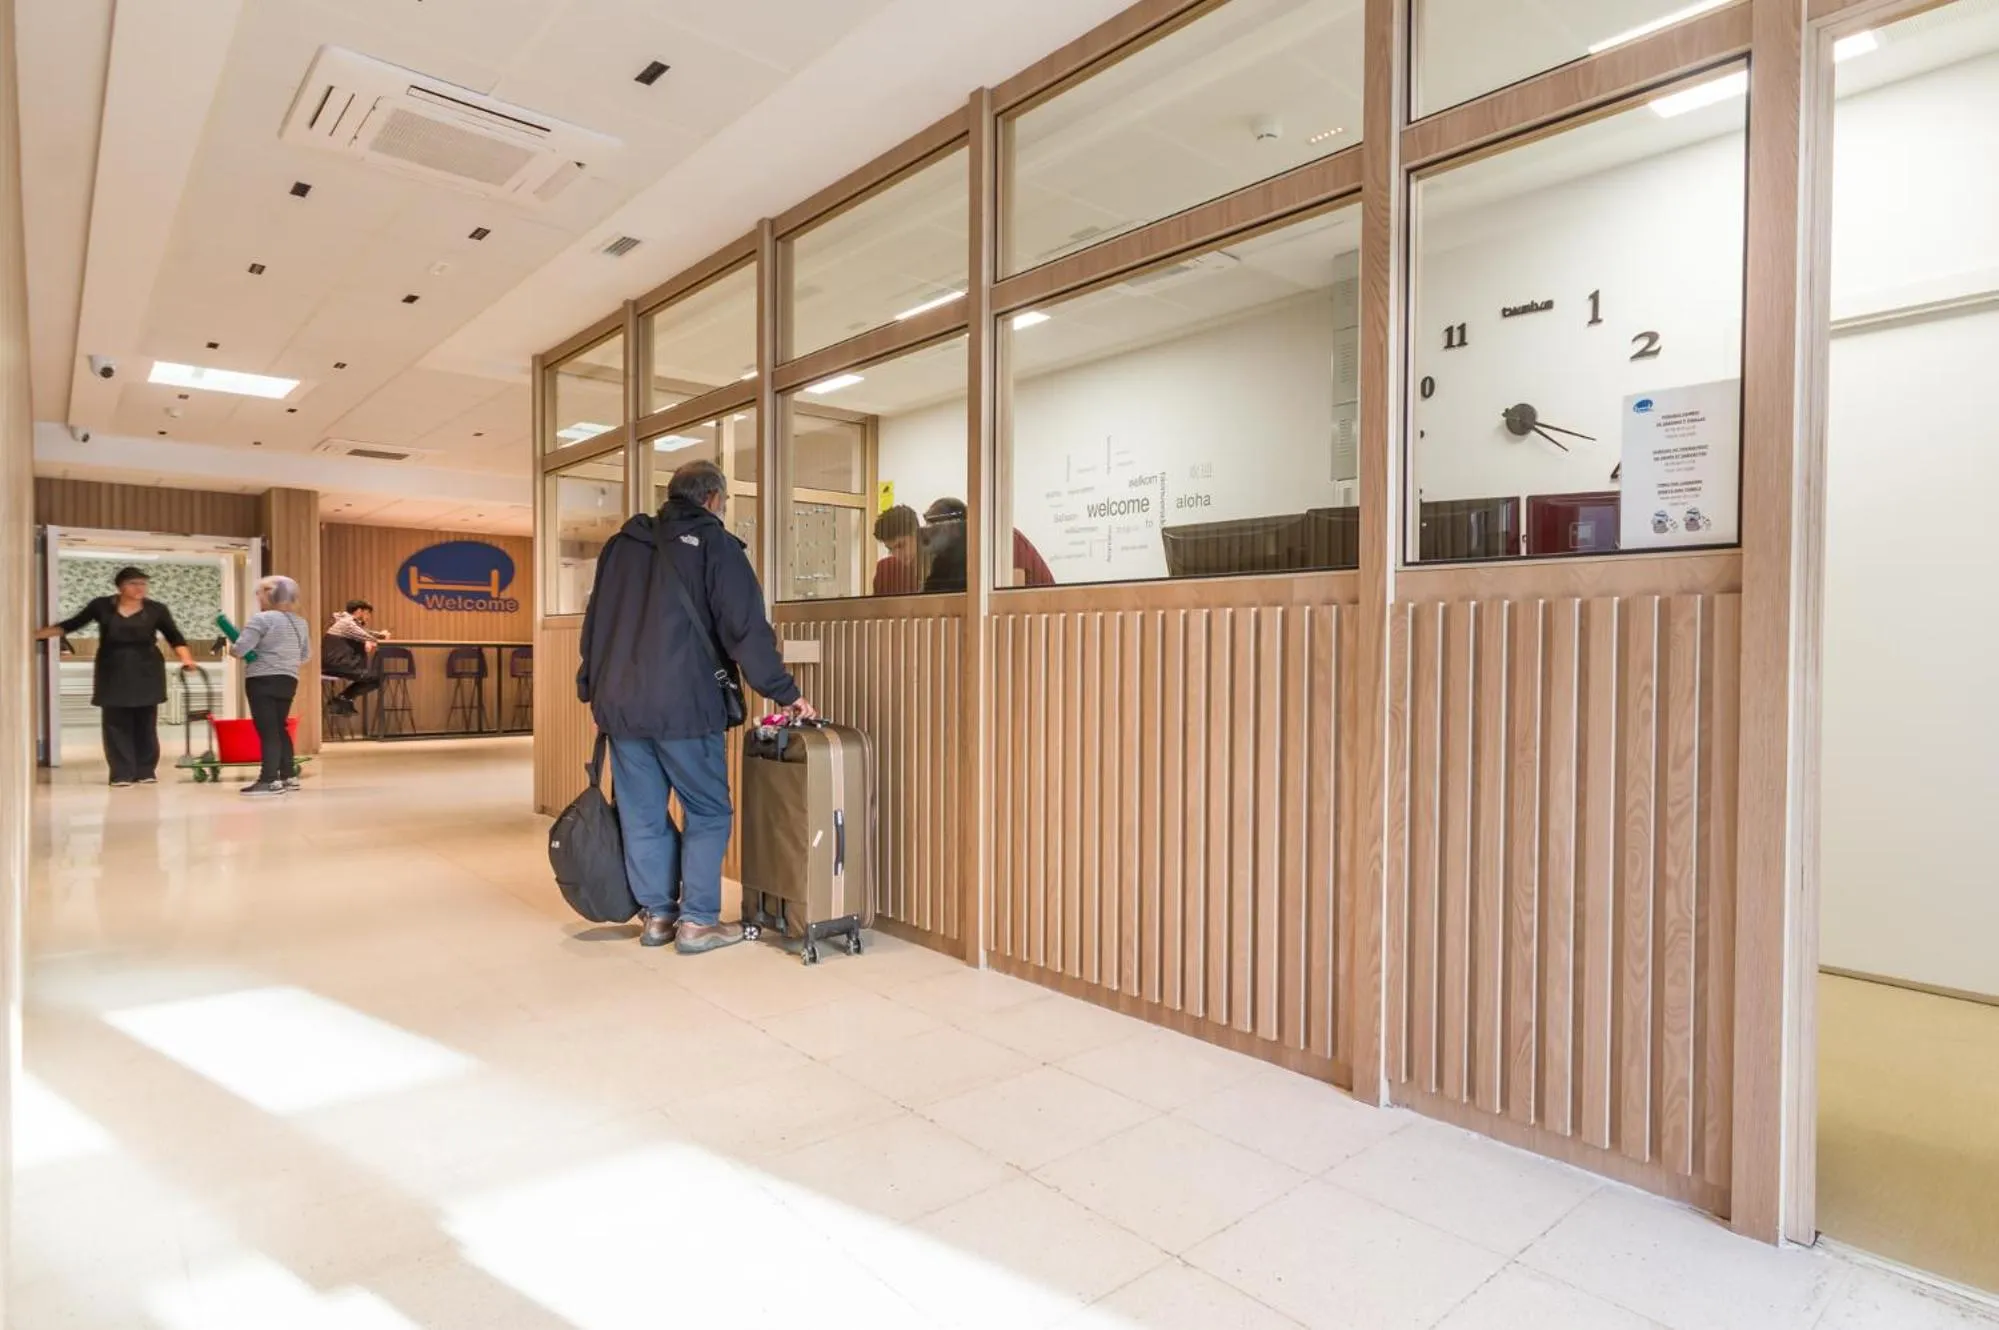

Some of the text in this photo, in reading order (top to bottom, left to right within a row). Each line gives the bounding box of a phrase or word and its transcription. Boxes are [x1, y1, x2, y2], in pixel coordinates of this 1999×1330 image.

[1588, 290, 1602, 325] 1
[1443, 322, 1468, 350] 11
[1630, 331, 1661, 361] 2
[1087, 495, 1150, 518] welcome
[1176, 493, 1211, 509] aloha
[424, 593, 518, 612] Welcome
